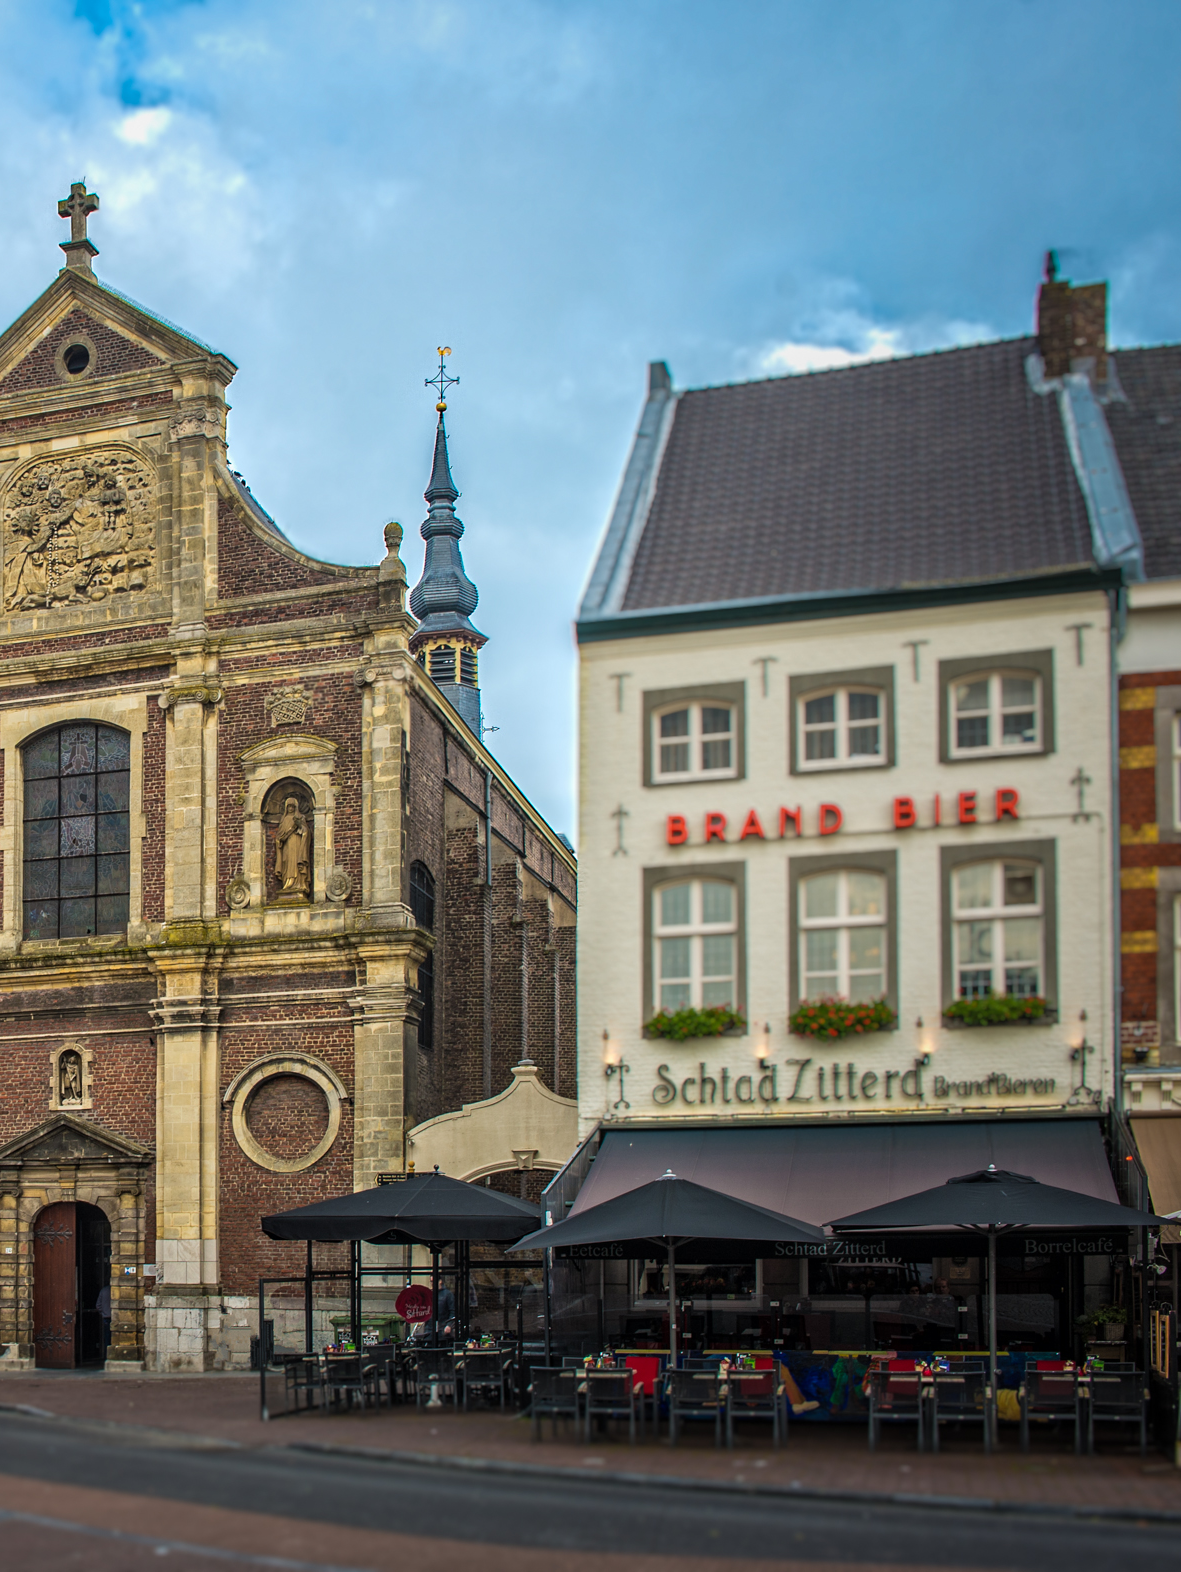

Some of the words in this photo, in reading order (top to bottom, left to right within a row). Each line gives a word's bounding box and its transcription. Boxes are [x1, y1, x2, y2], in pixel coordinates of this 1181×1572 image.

[666, 802, 844, 845] BRAND
[893, 788, 1020, 830] BIER
[652, 1062, 778, 1105] Schtad
[785, 1057, 925, 1101] Zitterd
[933, 1075, 991, 1098] Brand
[996, 1073, 1056, 1095] Bieren
[569, 1243, 624, 1257] Eetcafé
[775, 1240, 828, 1257] Schtad
[832, 1240, 886, 1256] Zitterd
[1024, 1237, 1113, 1254] Borrelcafé
